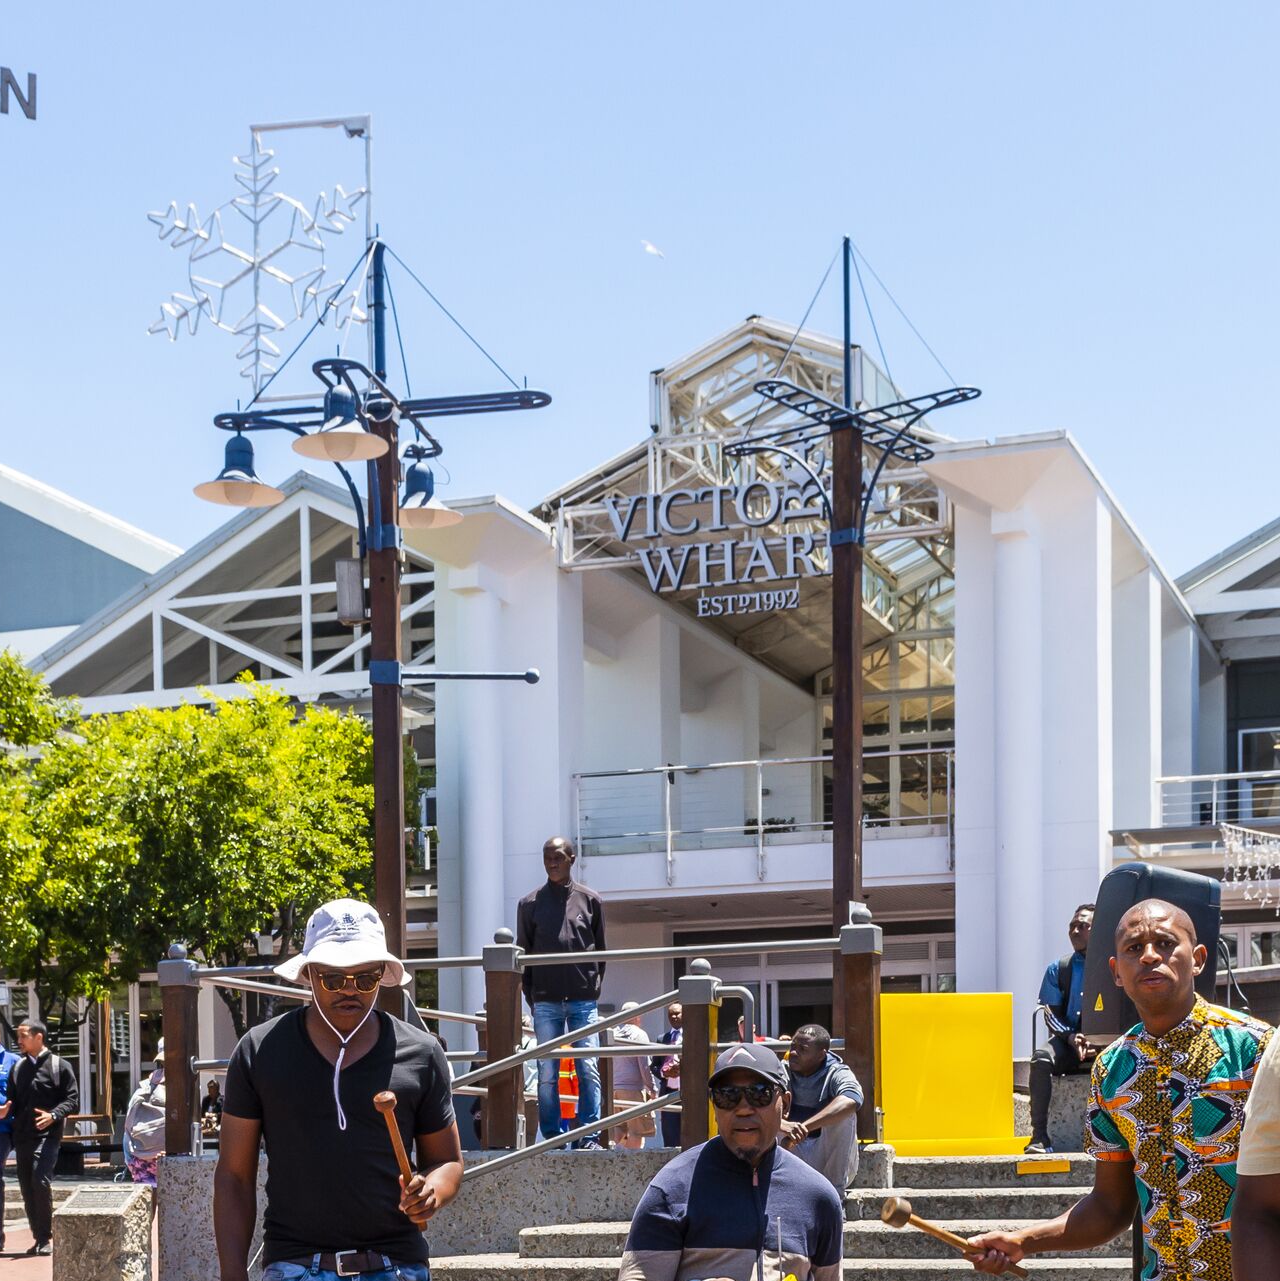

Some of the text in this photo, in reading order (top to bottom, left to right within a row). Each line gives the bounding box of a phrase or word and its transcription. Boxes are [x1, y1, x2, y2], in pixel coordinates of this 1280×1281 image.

[0, 66, 38, 120] N
[601, 468, 891, 543] VICTORA
[752, 588, 800, 614] 1992
